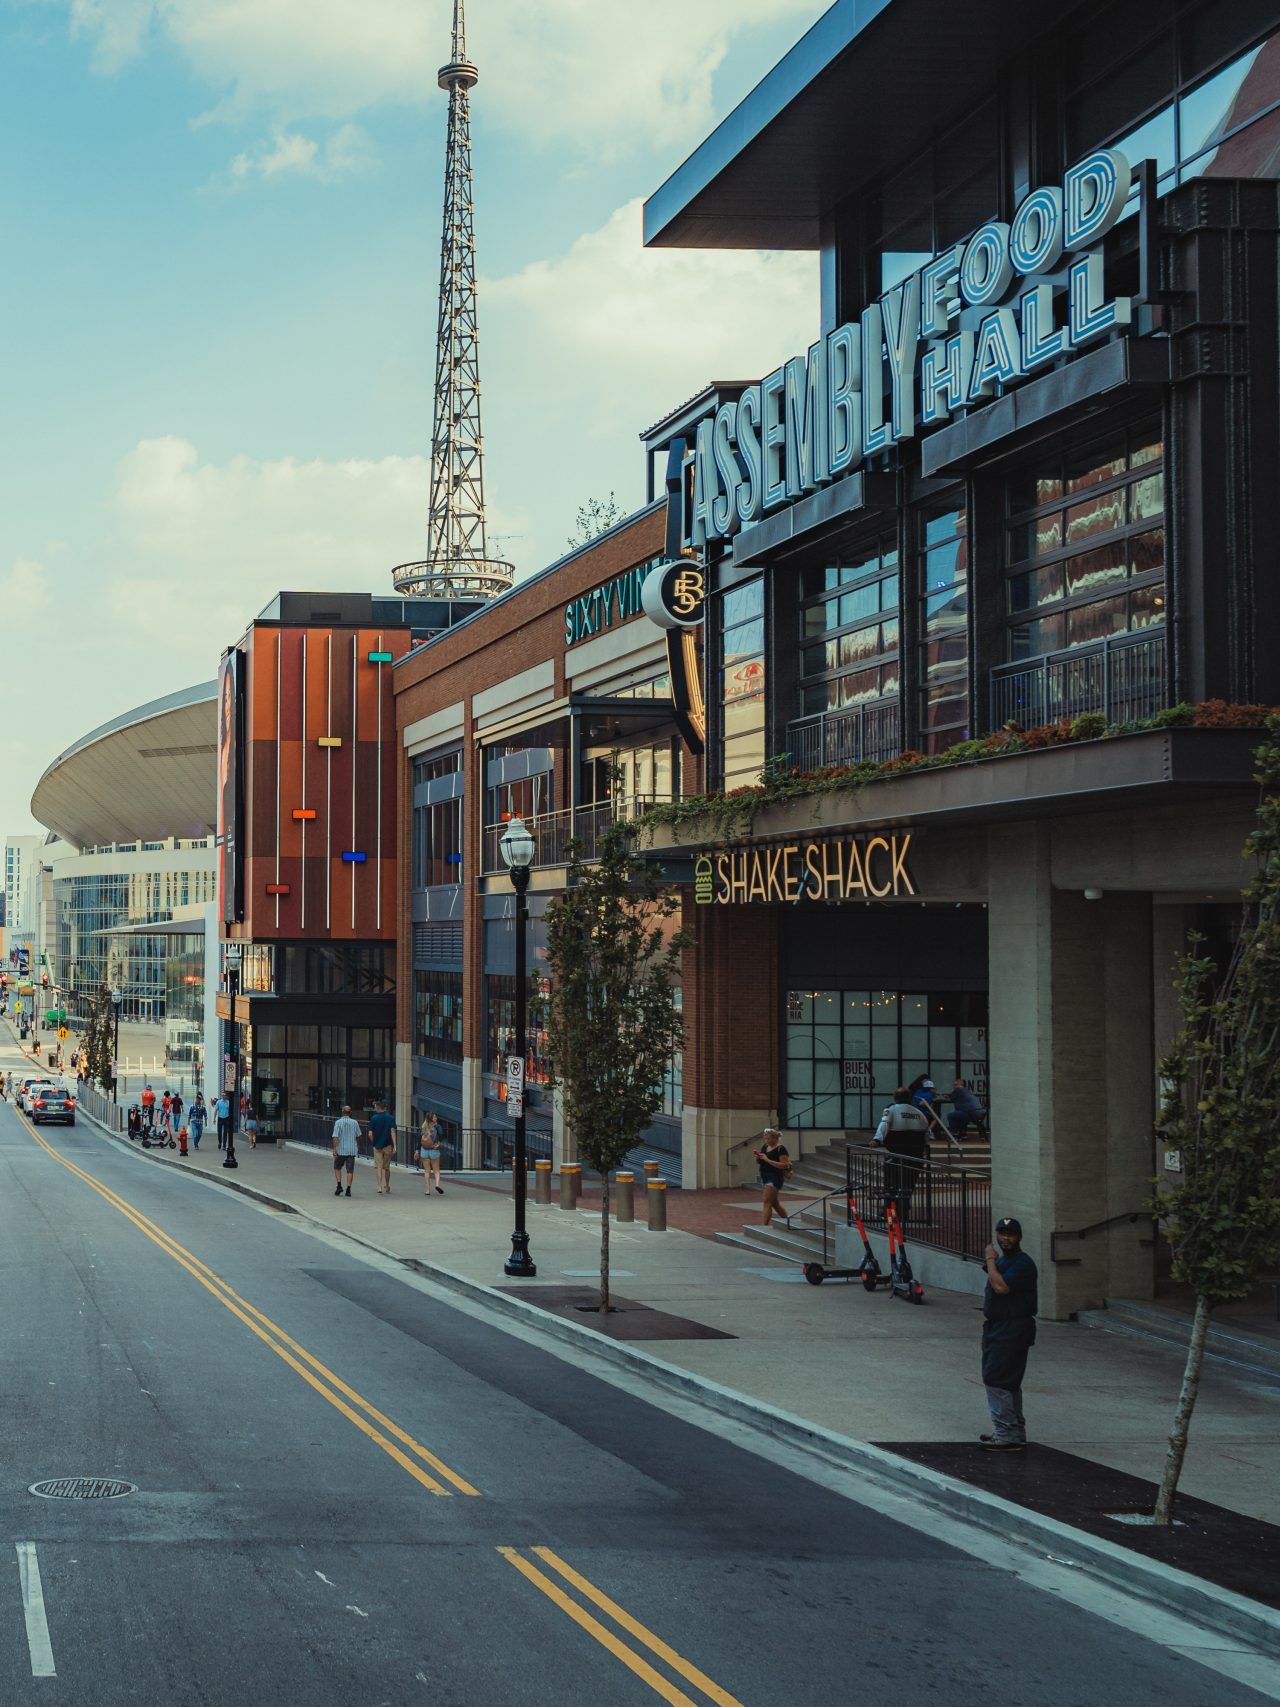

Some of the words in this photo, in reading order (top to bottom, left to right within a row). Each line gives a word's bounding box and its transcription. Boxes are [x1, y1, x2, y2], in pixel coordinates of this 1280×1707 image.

[921, 149, 1131, 339] FOOD
[921, 254, 1131, 427] HALL
[691, 272, 919, 548] ASSEMBLY
[565, 582, 615, 646] SIXTY
[717, 846, 800, 905] SHAKE
[806, 834, 915, 901] SHACK
[845, 1061, 872, 1075] BUEN
[845, 1075, 876, 1089] ROLLO
